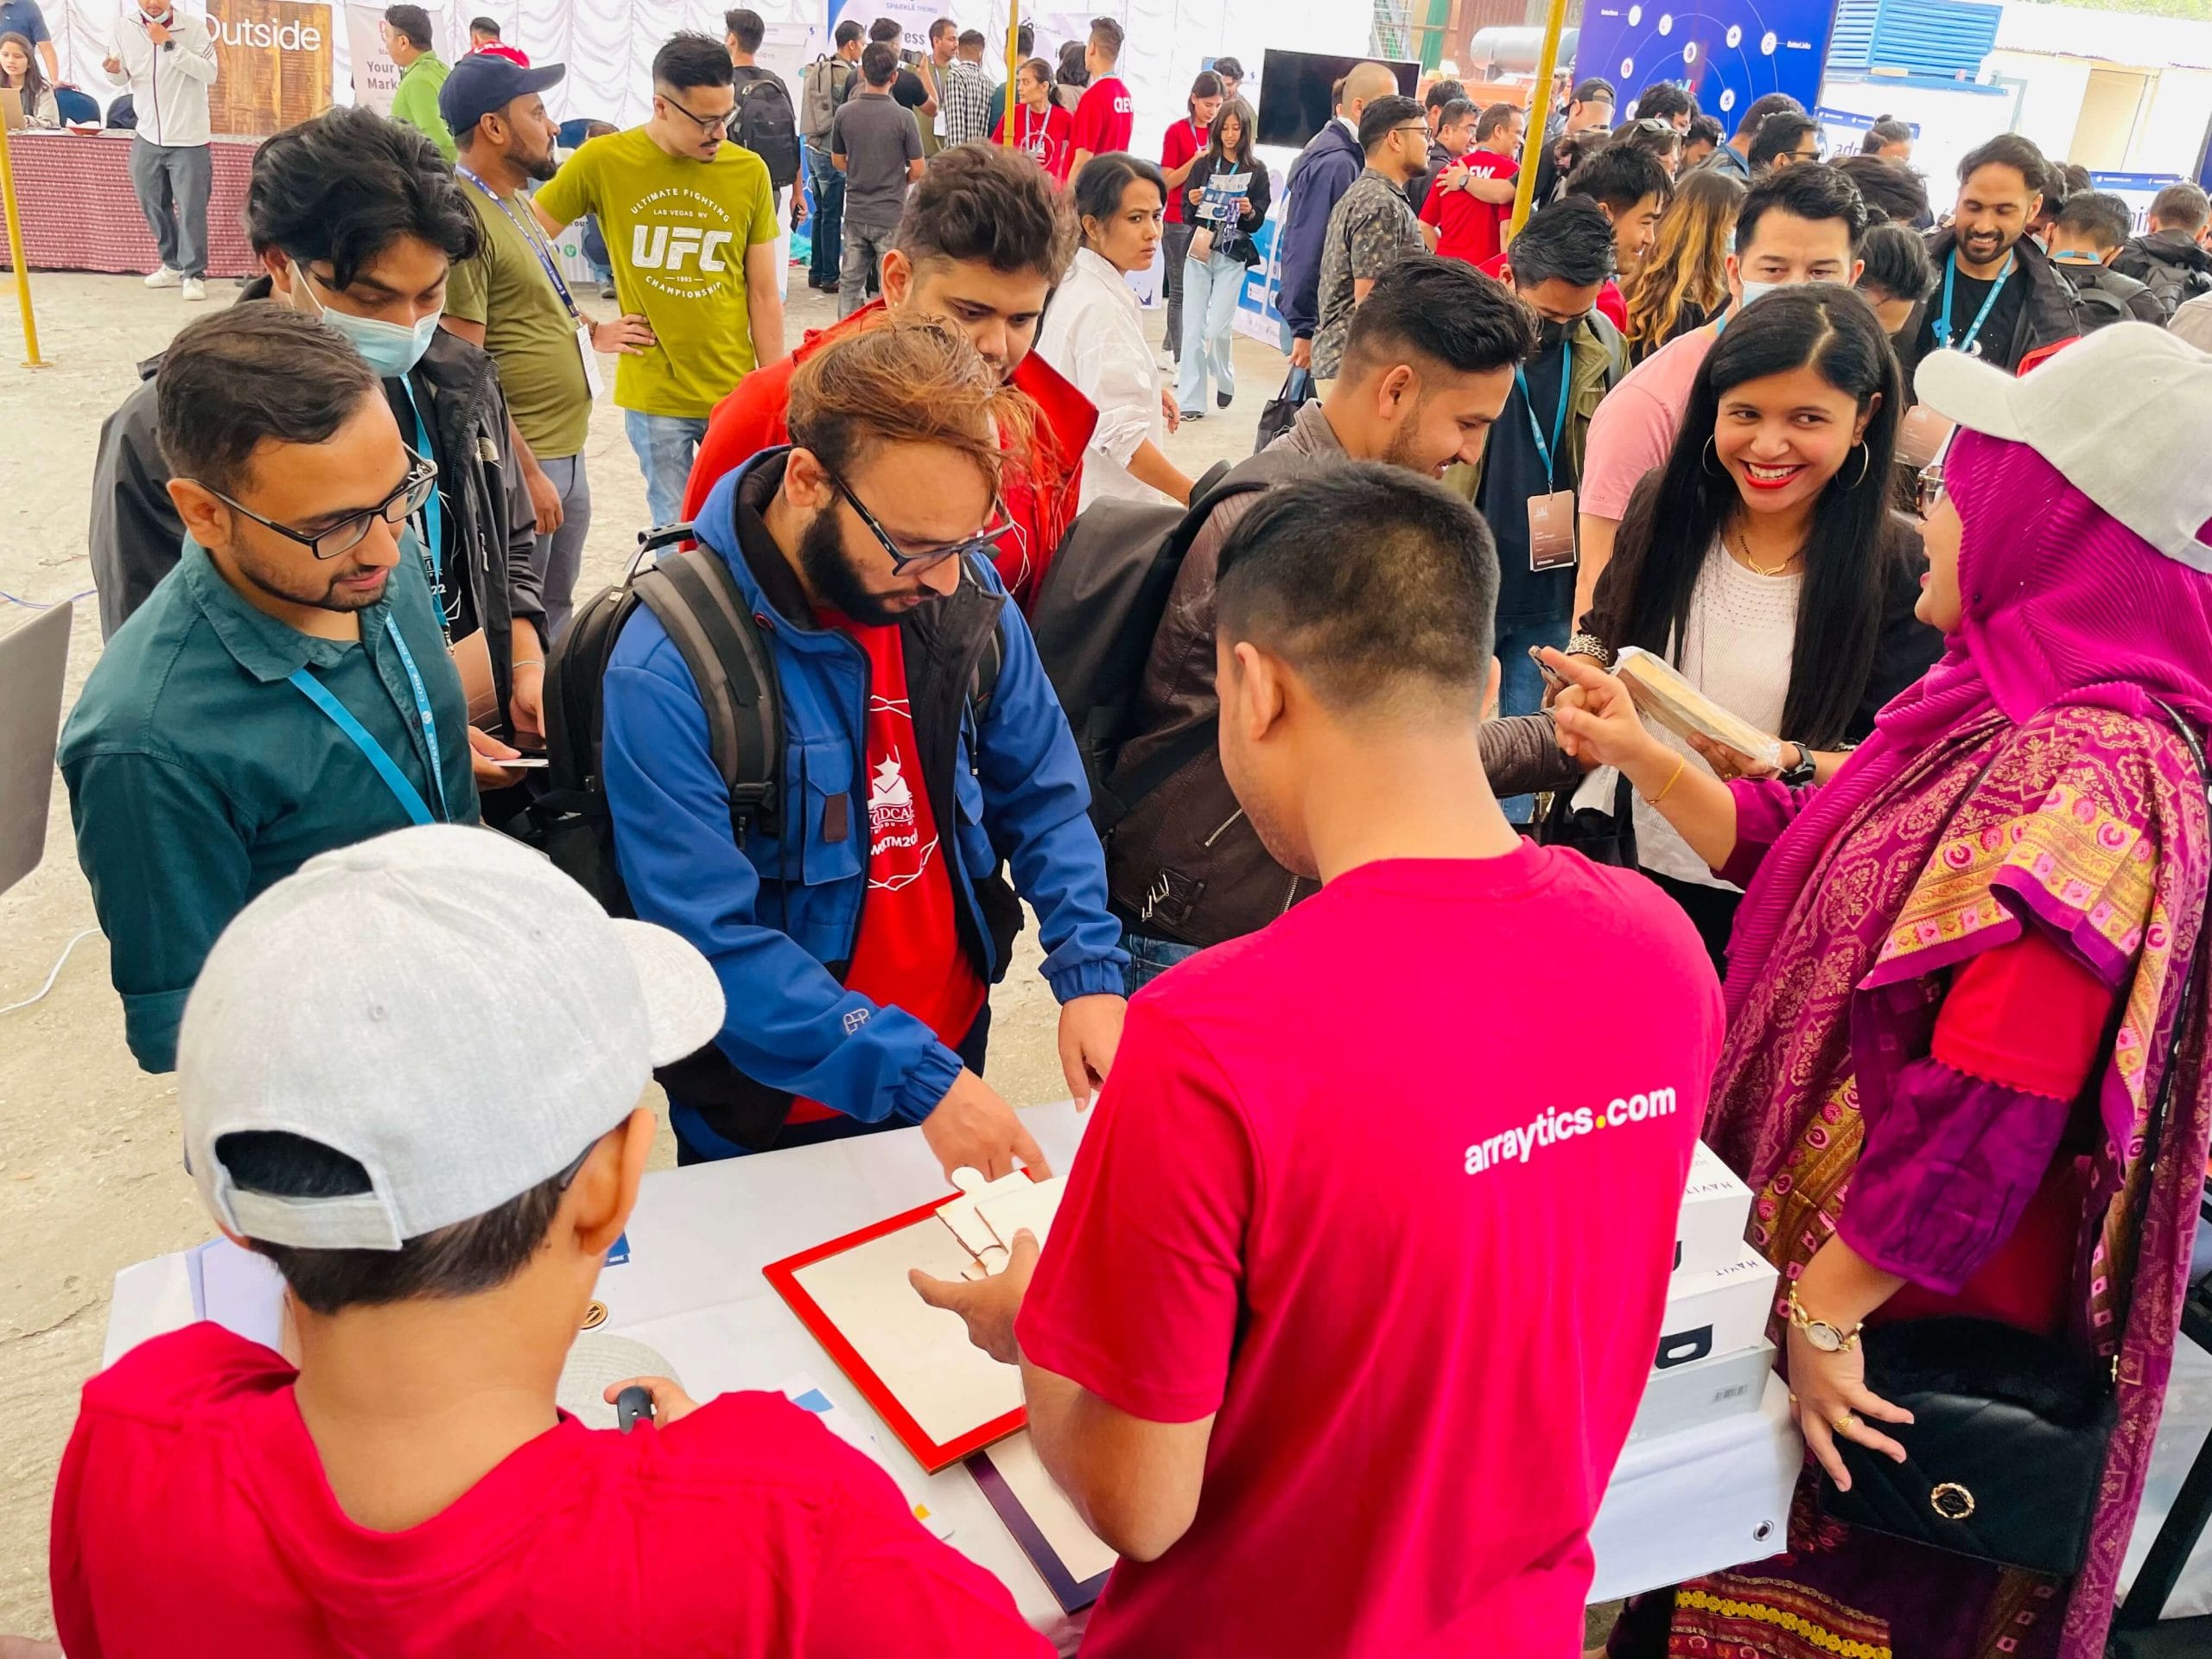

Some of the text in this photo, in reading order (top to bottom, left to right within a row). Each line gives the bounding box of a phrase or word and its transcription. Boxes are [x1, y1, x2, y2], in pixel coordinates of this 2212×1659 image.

[366, 60, 395, 73] Your
[367, 78, 400, 90] Mark
[1469, 165, 1497, 180] EW
[630, 188, 730, 223] ULTIMATE FIGHTING
[631, 225, 733, 272] UFC
[645, 276, 721, 298] CHAMPIONSHIP
[1464, 1086, 1676, 1175] arraytics.com
[1687, 1181, 1733, 1195] HAVIT
[1716, 1260, 1759, 1277] HAVIT
